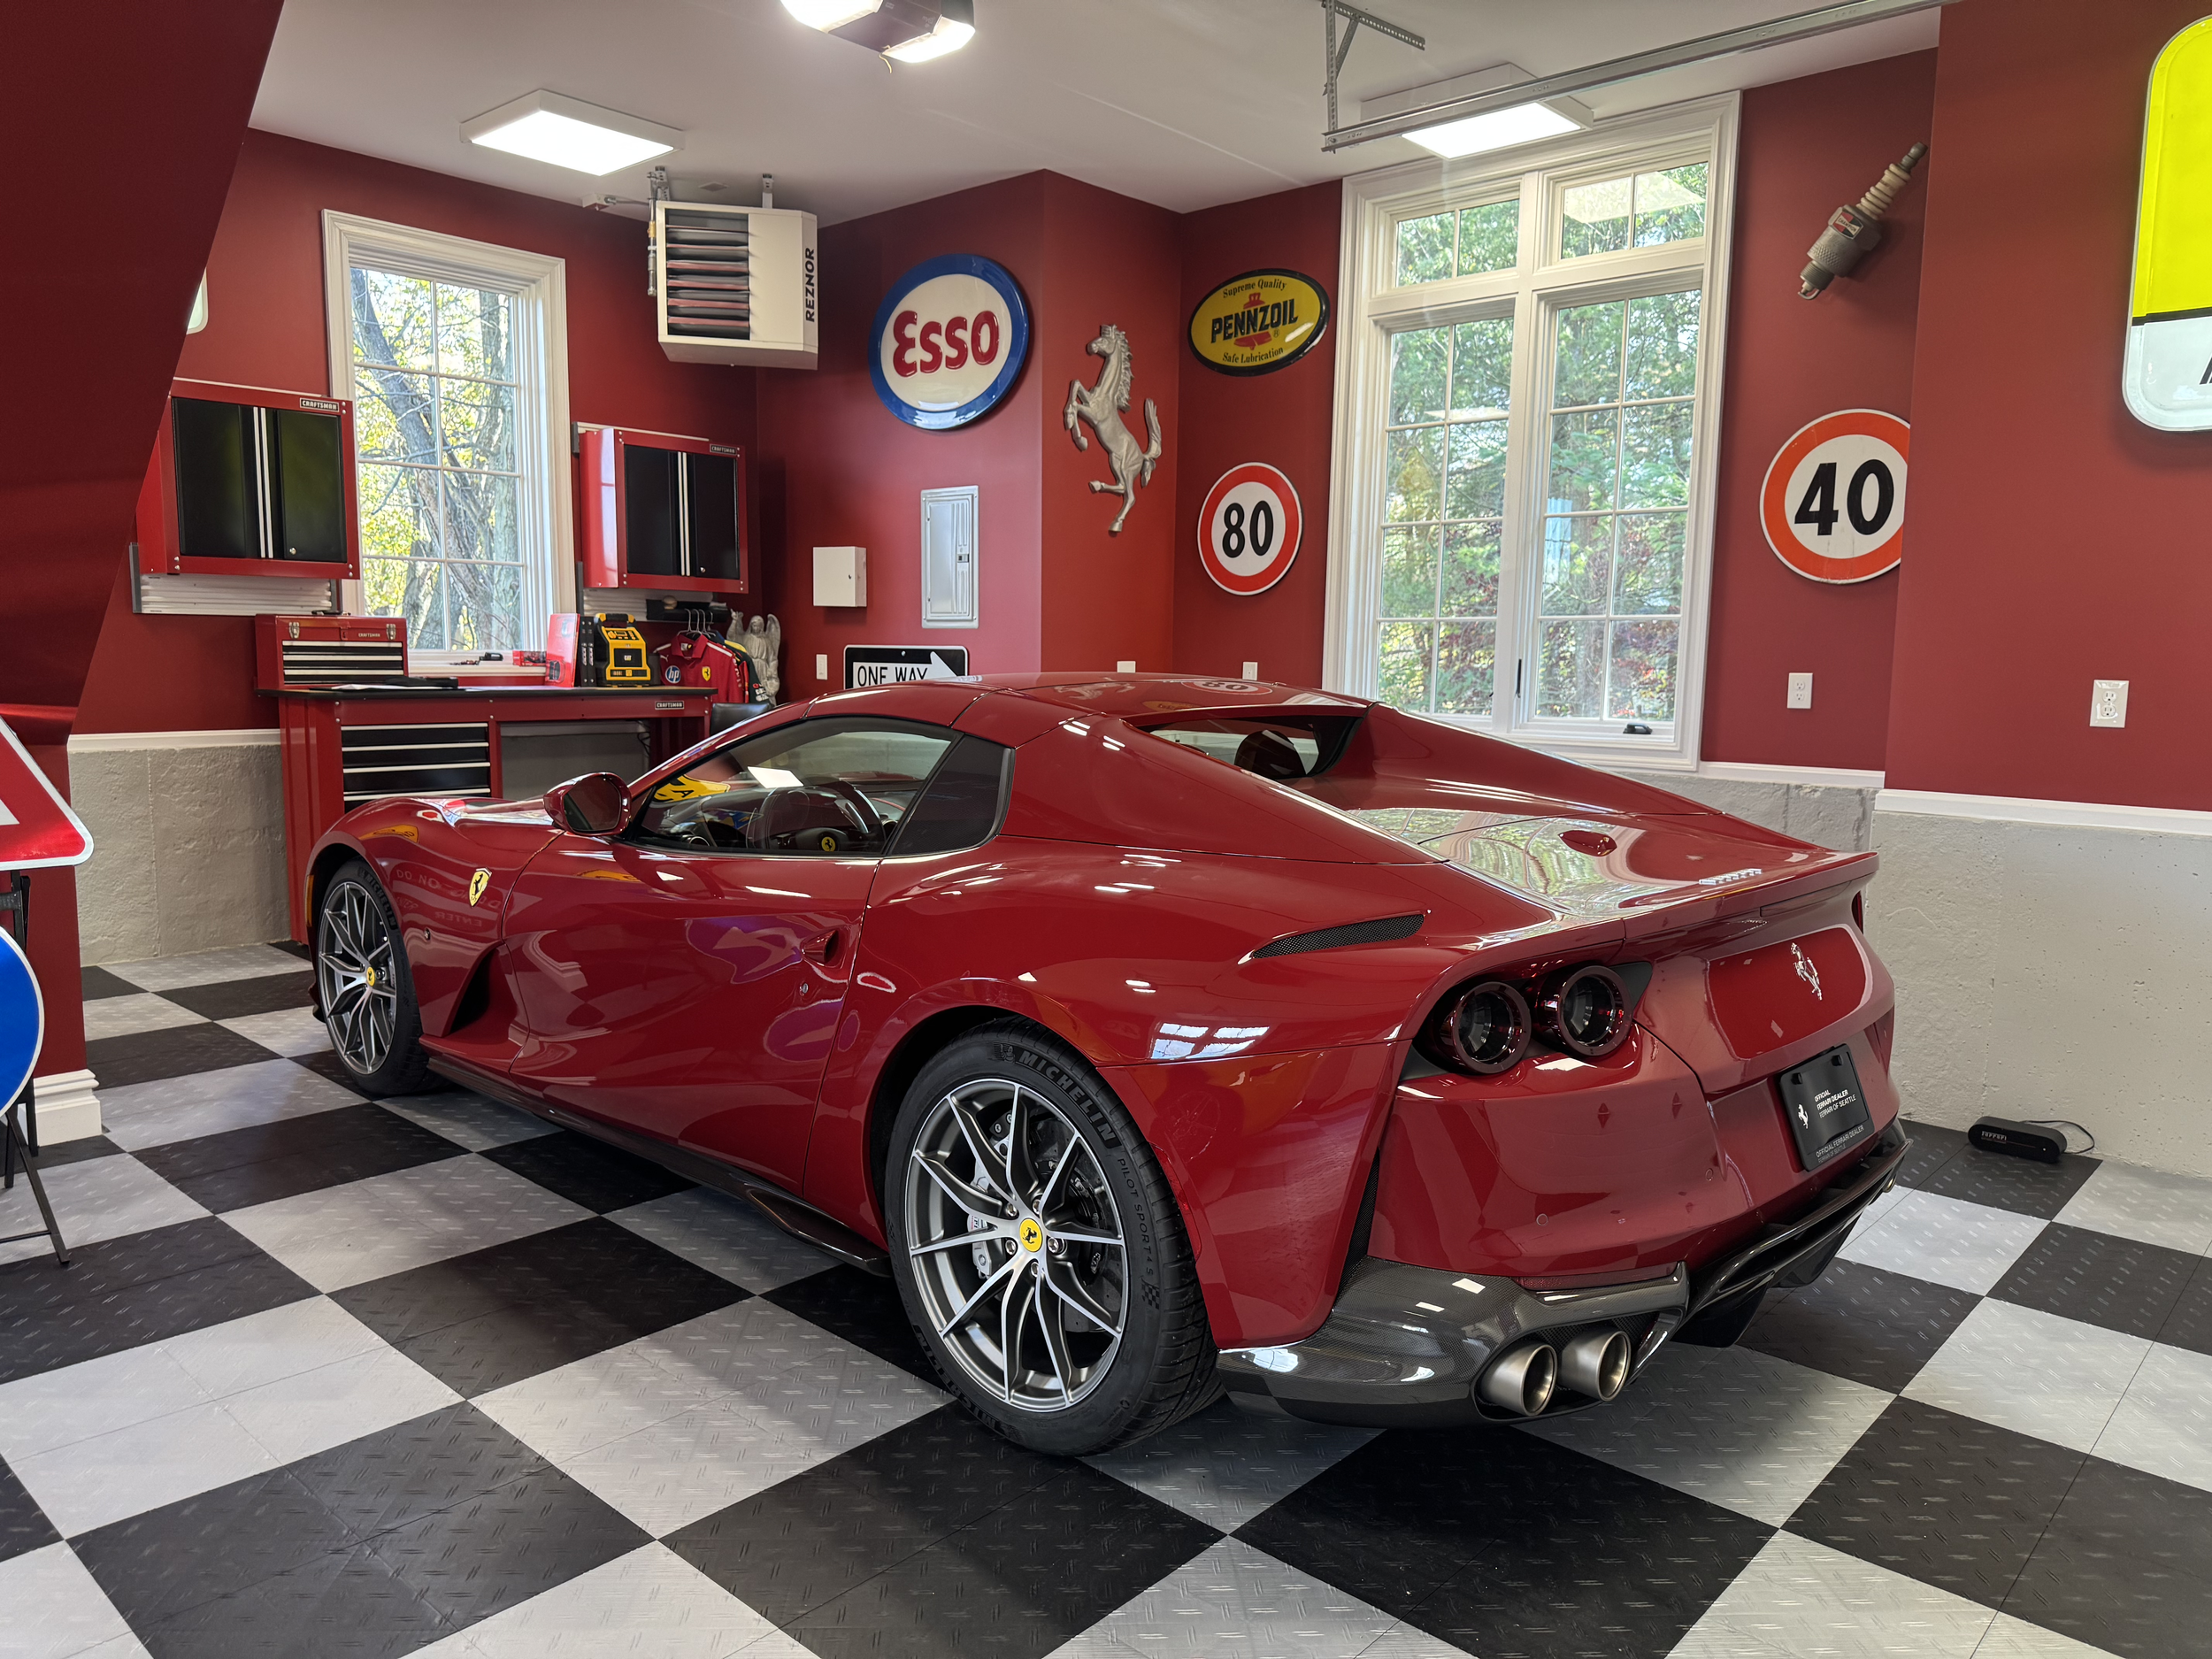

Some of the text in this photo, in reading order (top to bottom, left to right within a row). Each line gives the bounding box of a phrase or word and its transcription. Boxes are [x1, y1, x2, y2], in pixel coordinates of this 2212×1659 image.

[804, 247, 815, 322] REZNOR
[1223, 278, 1286, 298] Supreme Quality
[1210, 298, 1298, 343] PENNZOIL
[1222, 347, 1283, 364] Safe Lubrication
[302, 400, 337, 410] CRAFTSMAN
[1794, 458, 1894, 536] 40
[1222, 500, 1274, 558] 80
[668, 665, 680, 682] hp
[1018, 1050, 1116, 1142] MICHELIN
[1831, 1088, 1849, 1102] DEALER
[1839, 1094, 1857, 1108] SEATTLE
[1117, 1158, 1139, 1198] PILOT
[1134, 1204, 1152, 1255] SPORT
